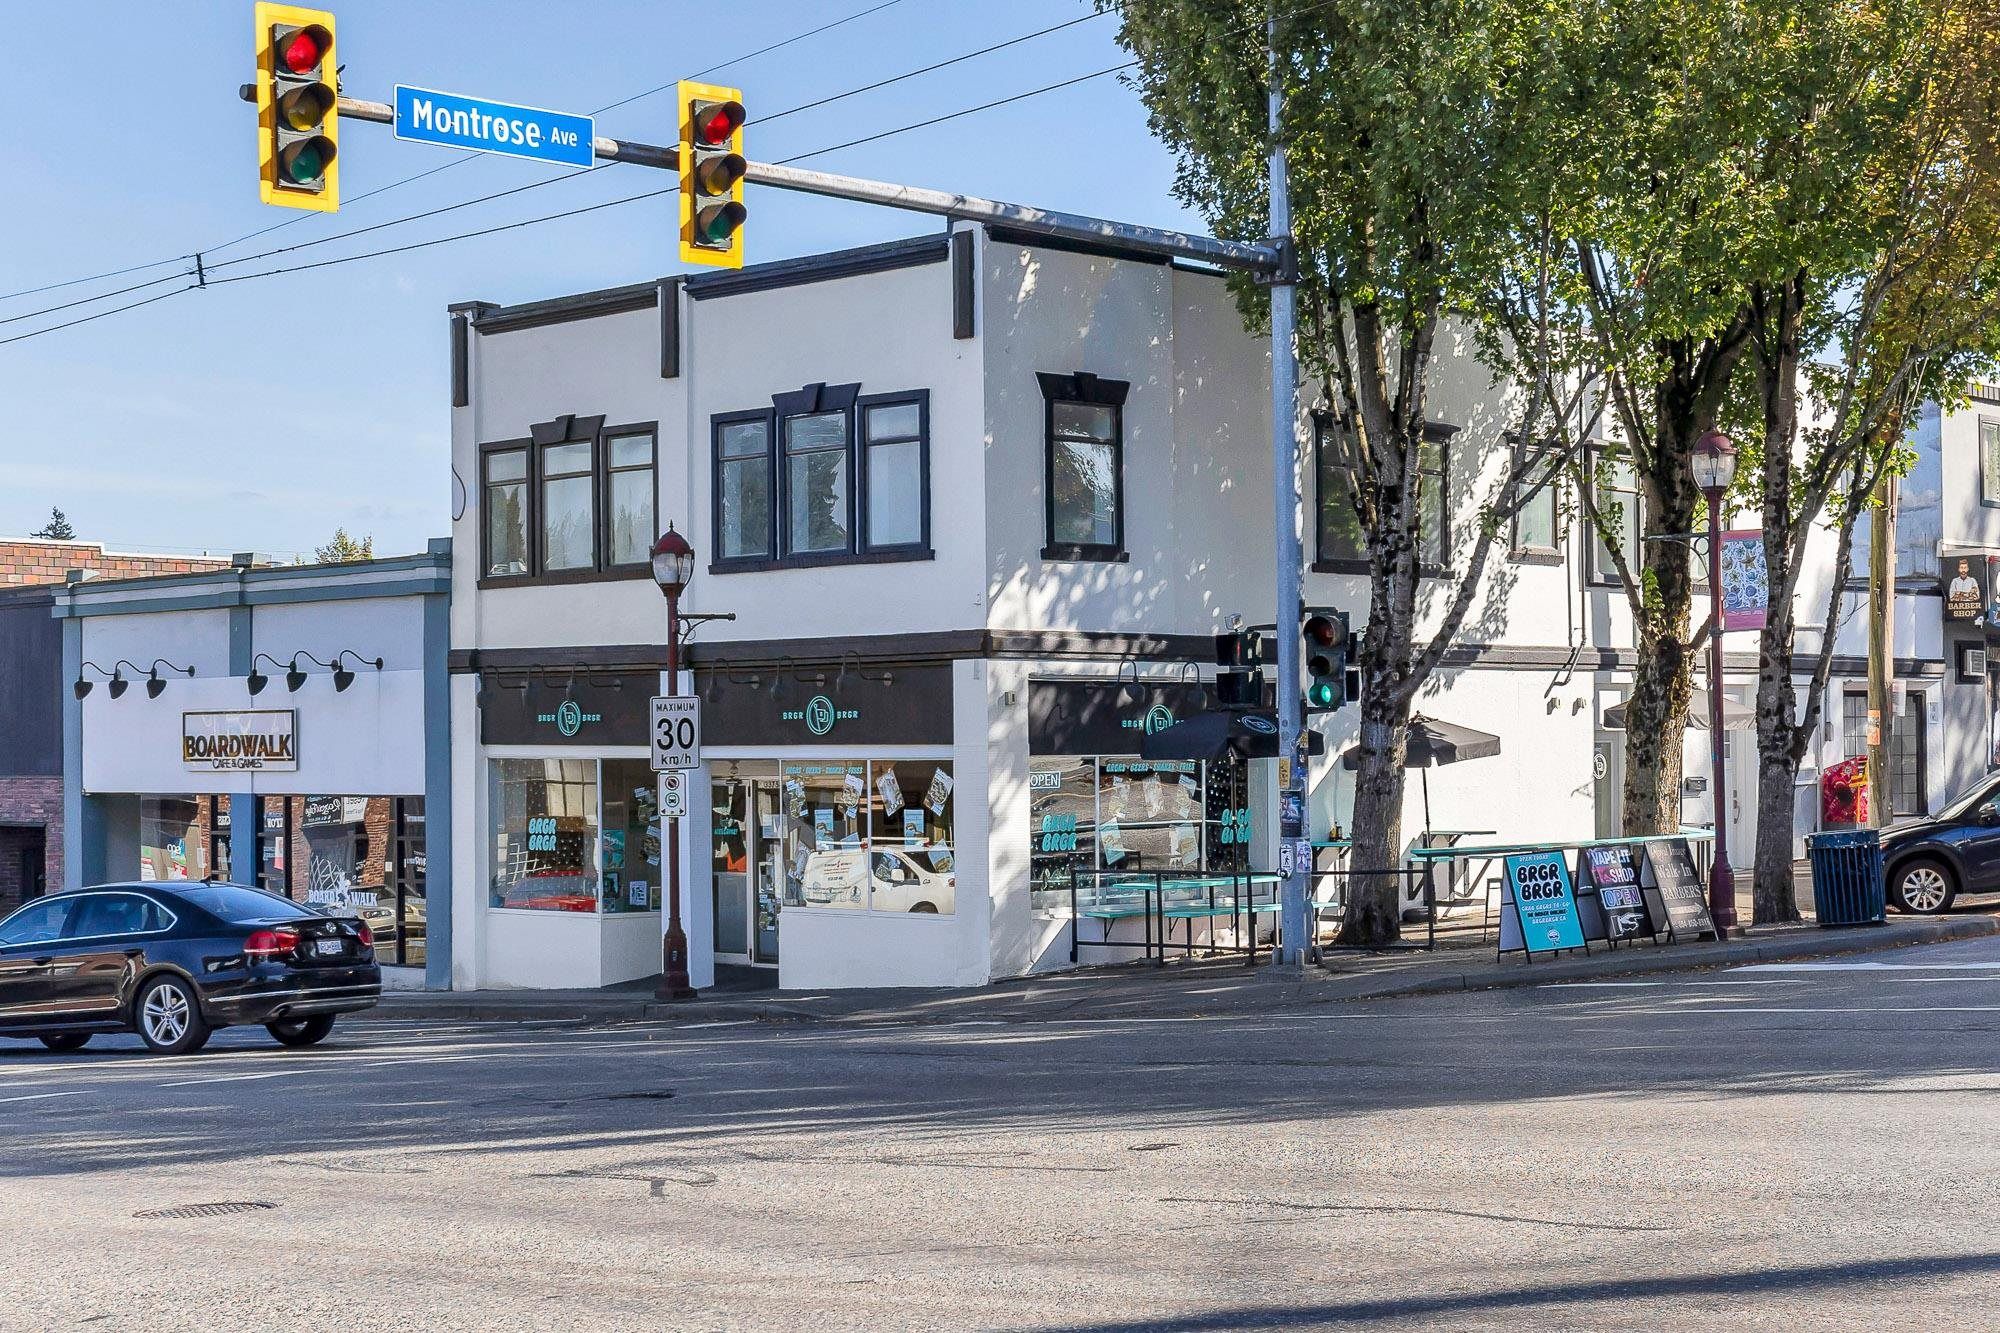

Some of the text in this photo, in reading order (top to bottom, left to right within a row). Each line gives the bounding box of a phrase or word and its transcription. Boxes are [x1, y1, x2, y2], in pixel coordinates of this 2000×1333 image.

[413, 98, 578, 147] Montrose Ave
[1948, 602, 1981, 610] BARBER
[656, 703, 695, 712] MAXIMUM
[783, 710, 858, 720] BRGR BRGR
[538, 714, 555, 722] BRGR
[656, 718, 695, 750] 30
[184, 734, 291, 757] BOARDWALK
[661, 753, 691, 766] km/h
[1030, 774, 1058, 786] OPEN
[529, 817, 556, 834] BRGR
[1042, 814, 1076, 832] BRGR
[529, 835, 556, 850] BRGR
[1042, 833, 1076, 851] BRGR
[1592, 850, 1617, 866] VAPE
[1517, 862, 1559, 884] BRGR
[1609, 867, 1635, 883] SHOP
[309, 889, 378, 906] BOARD WALK
[1521, 880, 1564, 901] BRGR
[1604, 887, 1639, 907] OPEN
[1661, 884, 1702, 900] BARBERS
